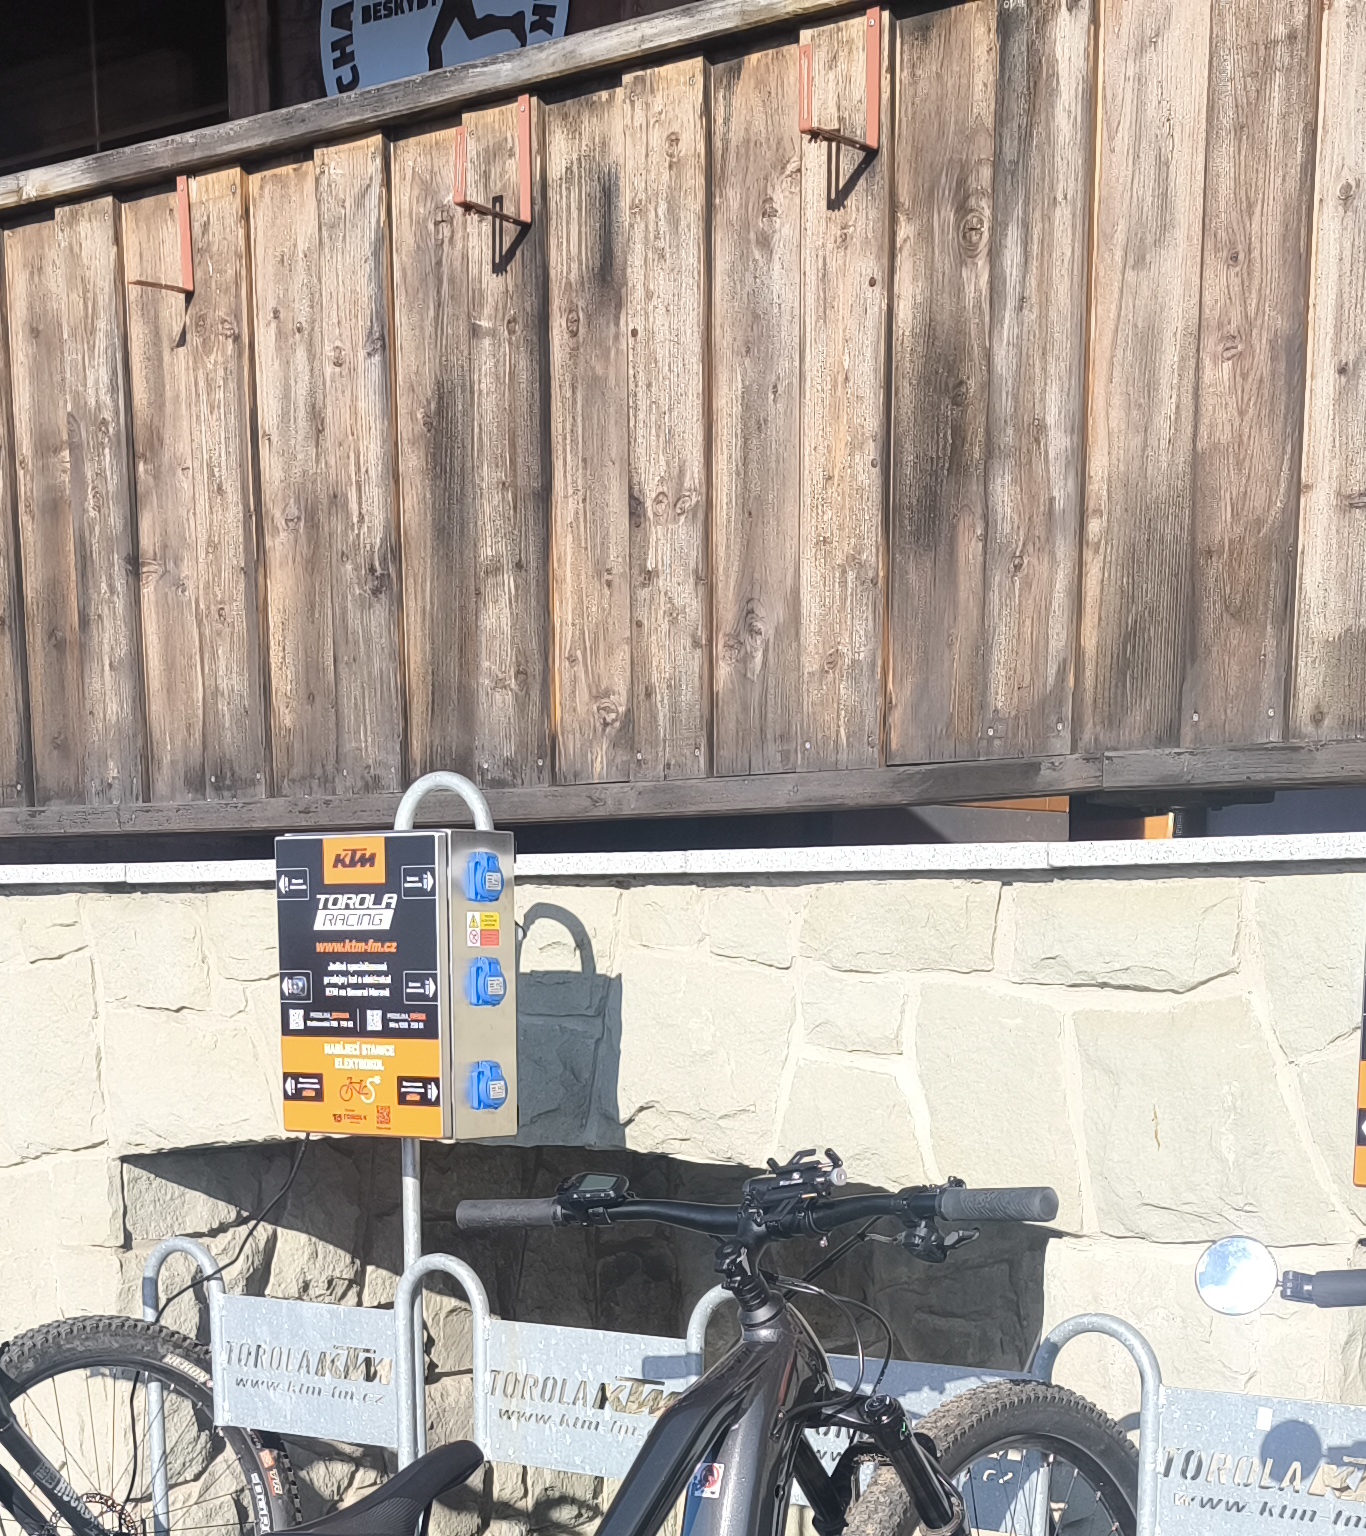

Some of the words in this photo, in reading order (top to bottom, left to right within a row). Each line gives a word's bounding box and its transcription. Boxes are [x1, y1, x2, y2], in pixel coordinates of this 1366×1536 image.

[332, 848, 377, 869] KTM
[316, 893, 397, 909] TOROLA
[322, 913, 384, 926] RACING
[316, 939, 397, 953] www.ktm-fm.cz
[490, 1368, 587, 1407] TOROLA
[1159, 1447, 1302, 1493] TOROLA
